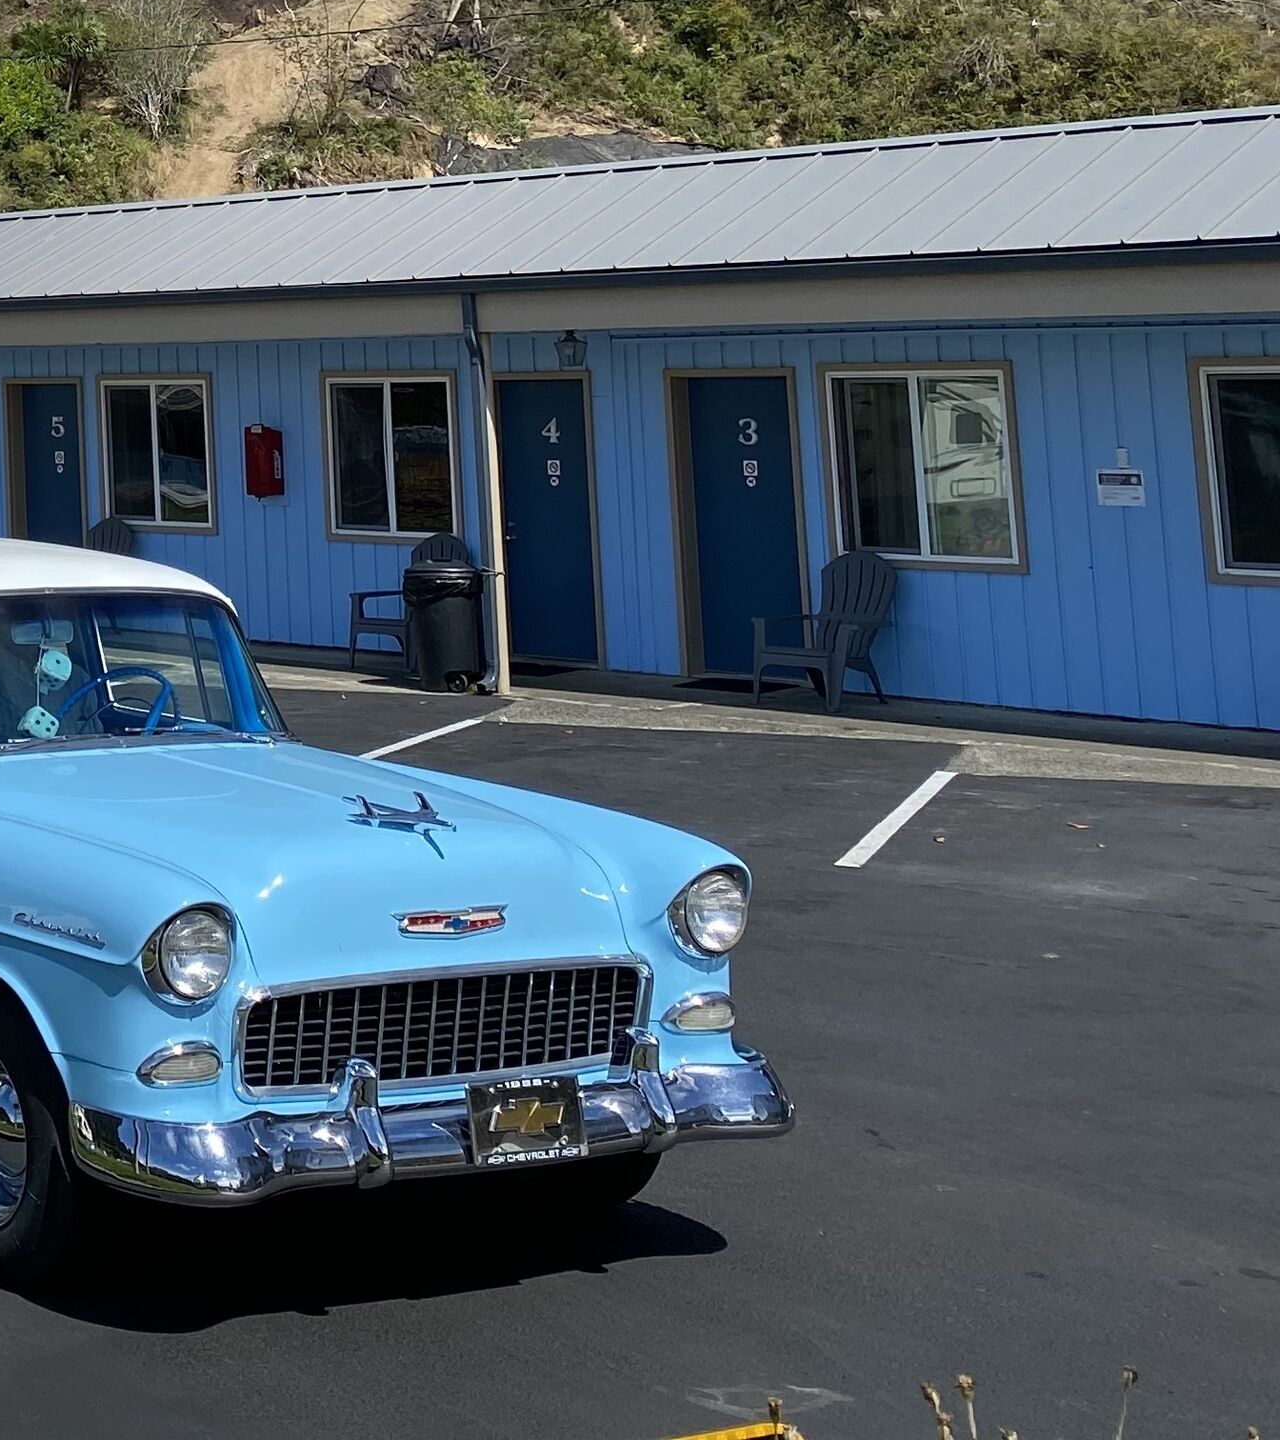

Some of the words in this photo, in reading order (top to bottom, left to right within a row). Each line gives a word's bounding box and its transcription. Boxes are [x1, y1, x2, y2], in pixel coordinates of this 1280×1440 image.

[51, 416, 65, 437] 5
[541, 417, 561, 444] 4
[738, 418, 759, 446] 3
[506, 1149, 560, 1162] CHEVROLET
